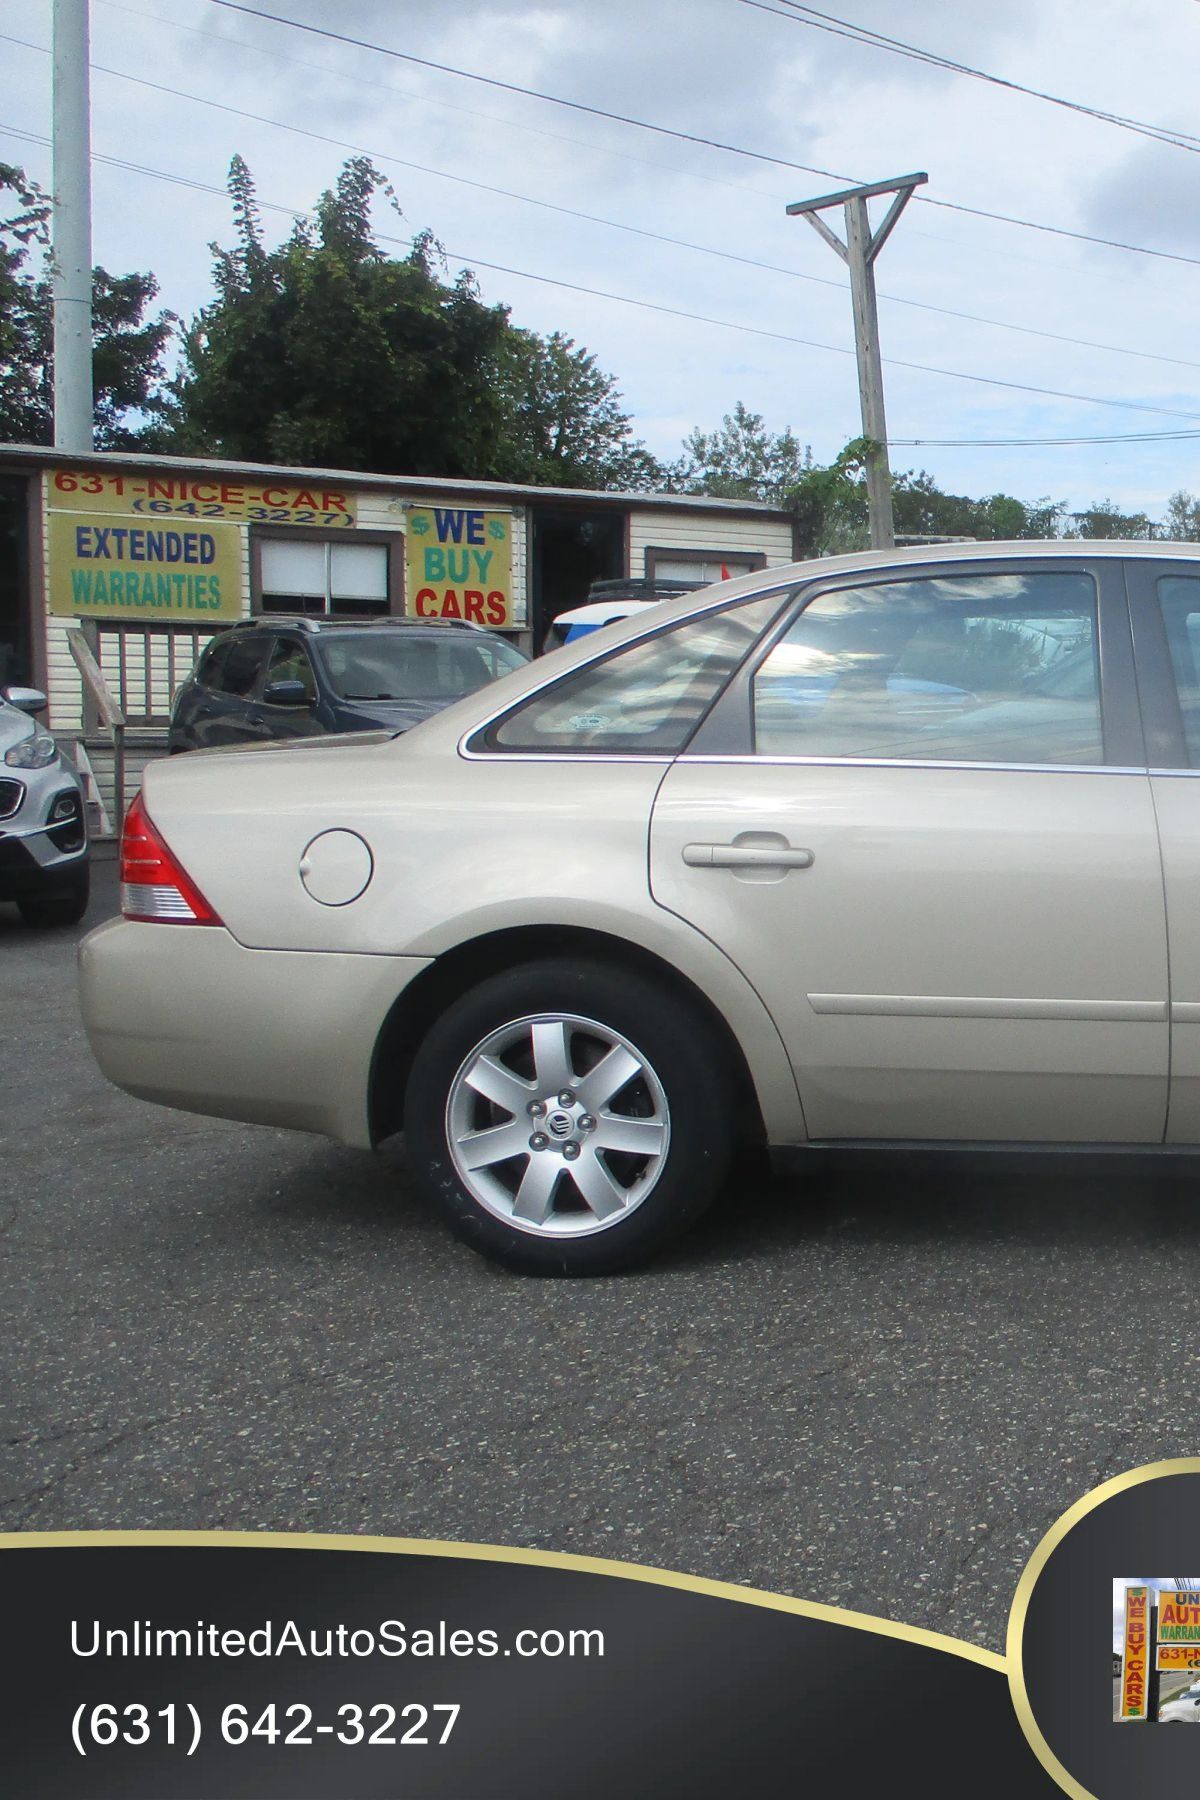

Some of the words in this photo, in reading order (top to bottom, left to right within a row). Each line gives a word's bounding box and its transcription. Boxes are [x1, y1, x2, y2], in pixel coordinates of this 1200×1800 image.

[54, 471, 348, 513] 631-NICE-CAR
[132, 499, 354, 527] (642-3227)
[434, 508, 486, 546] WE
[75, 525, 216, 565] EXTENDED
[424, 547, 494, 584] BUY
[71, 568, 223, 610] WARRANTIES
[415, 588, 507, 626] CARS
